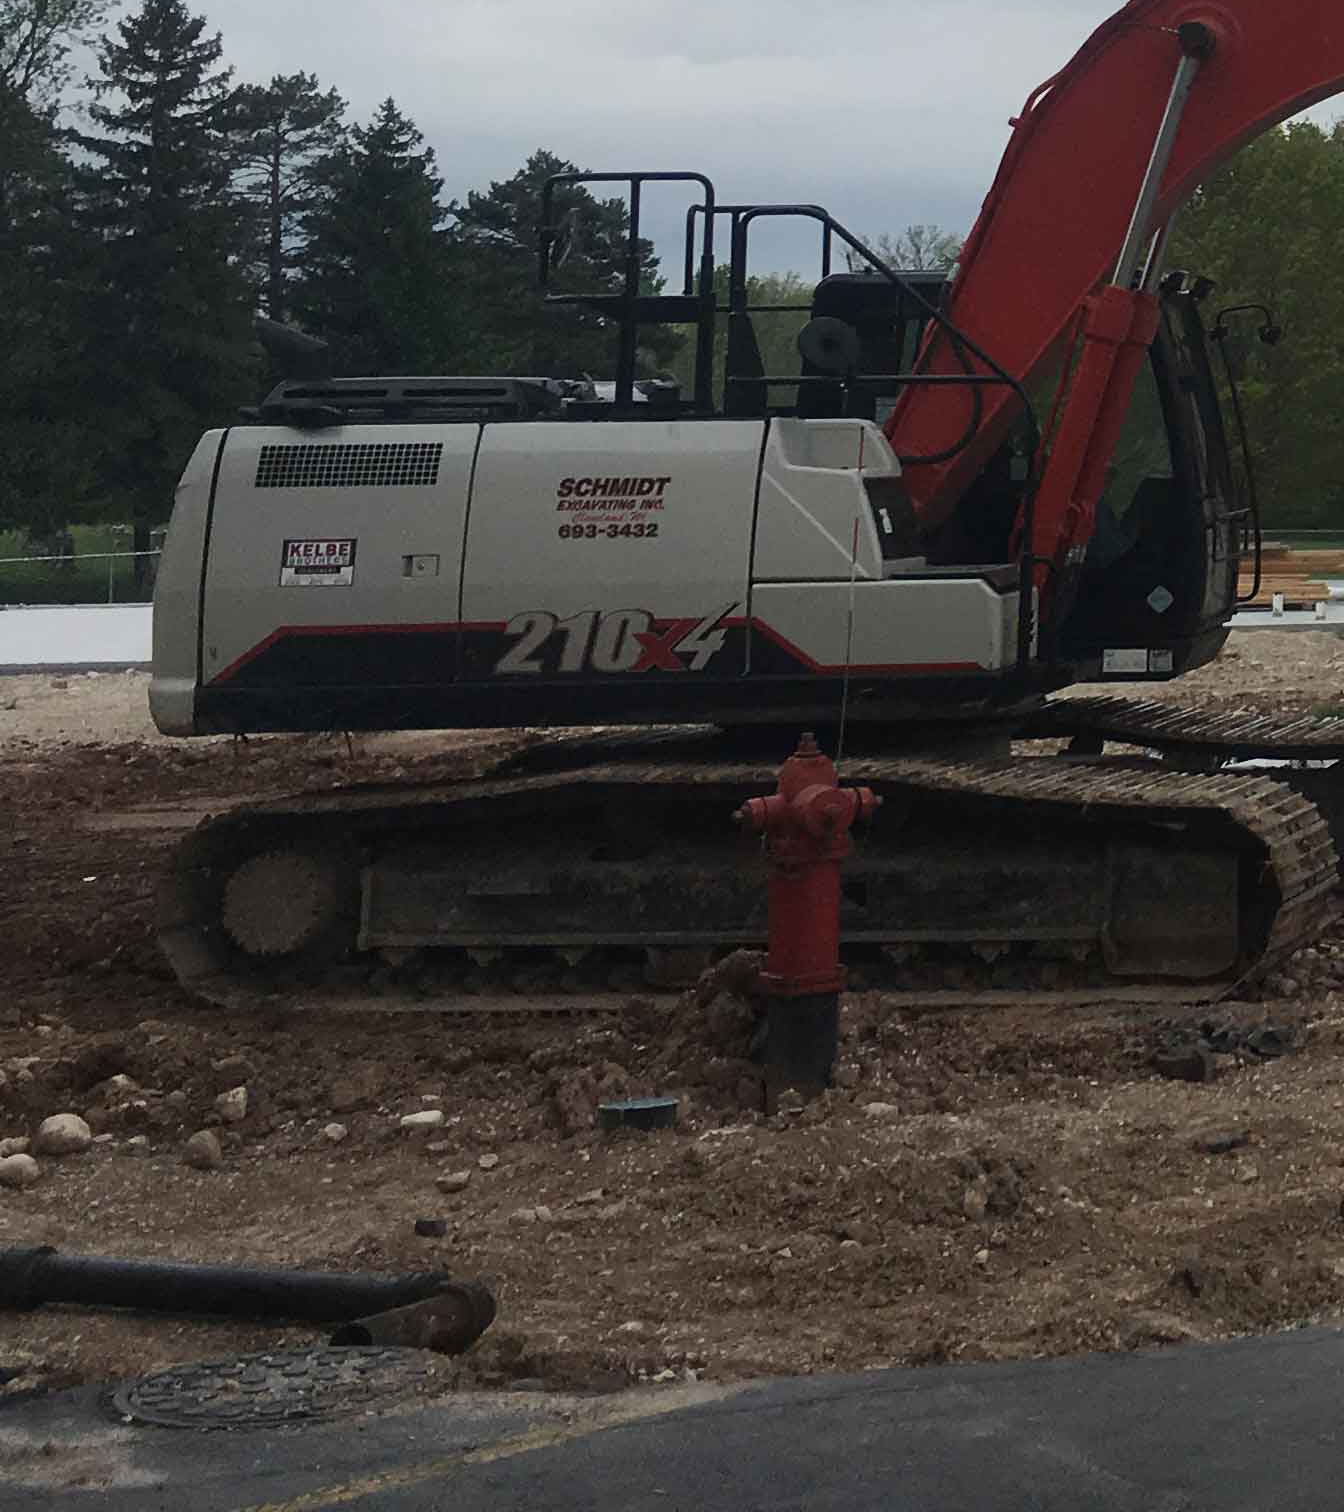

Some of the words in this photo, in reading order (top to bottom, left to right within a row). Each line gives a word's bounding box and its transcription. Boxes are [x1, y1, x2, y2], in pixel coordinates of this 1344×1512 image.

[557, 477, 671, 497] SCHMIDT
[556, 499, 637, 511] EXCAVATING
[558, 523, 659, 538] 693-3432
[289, 543, 350, 557] KELBE
